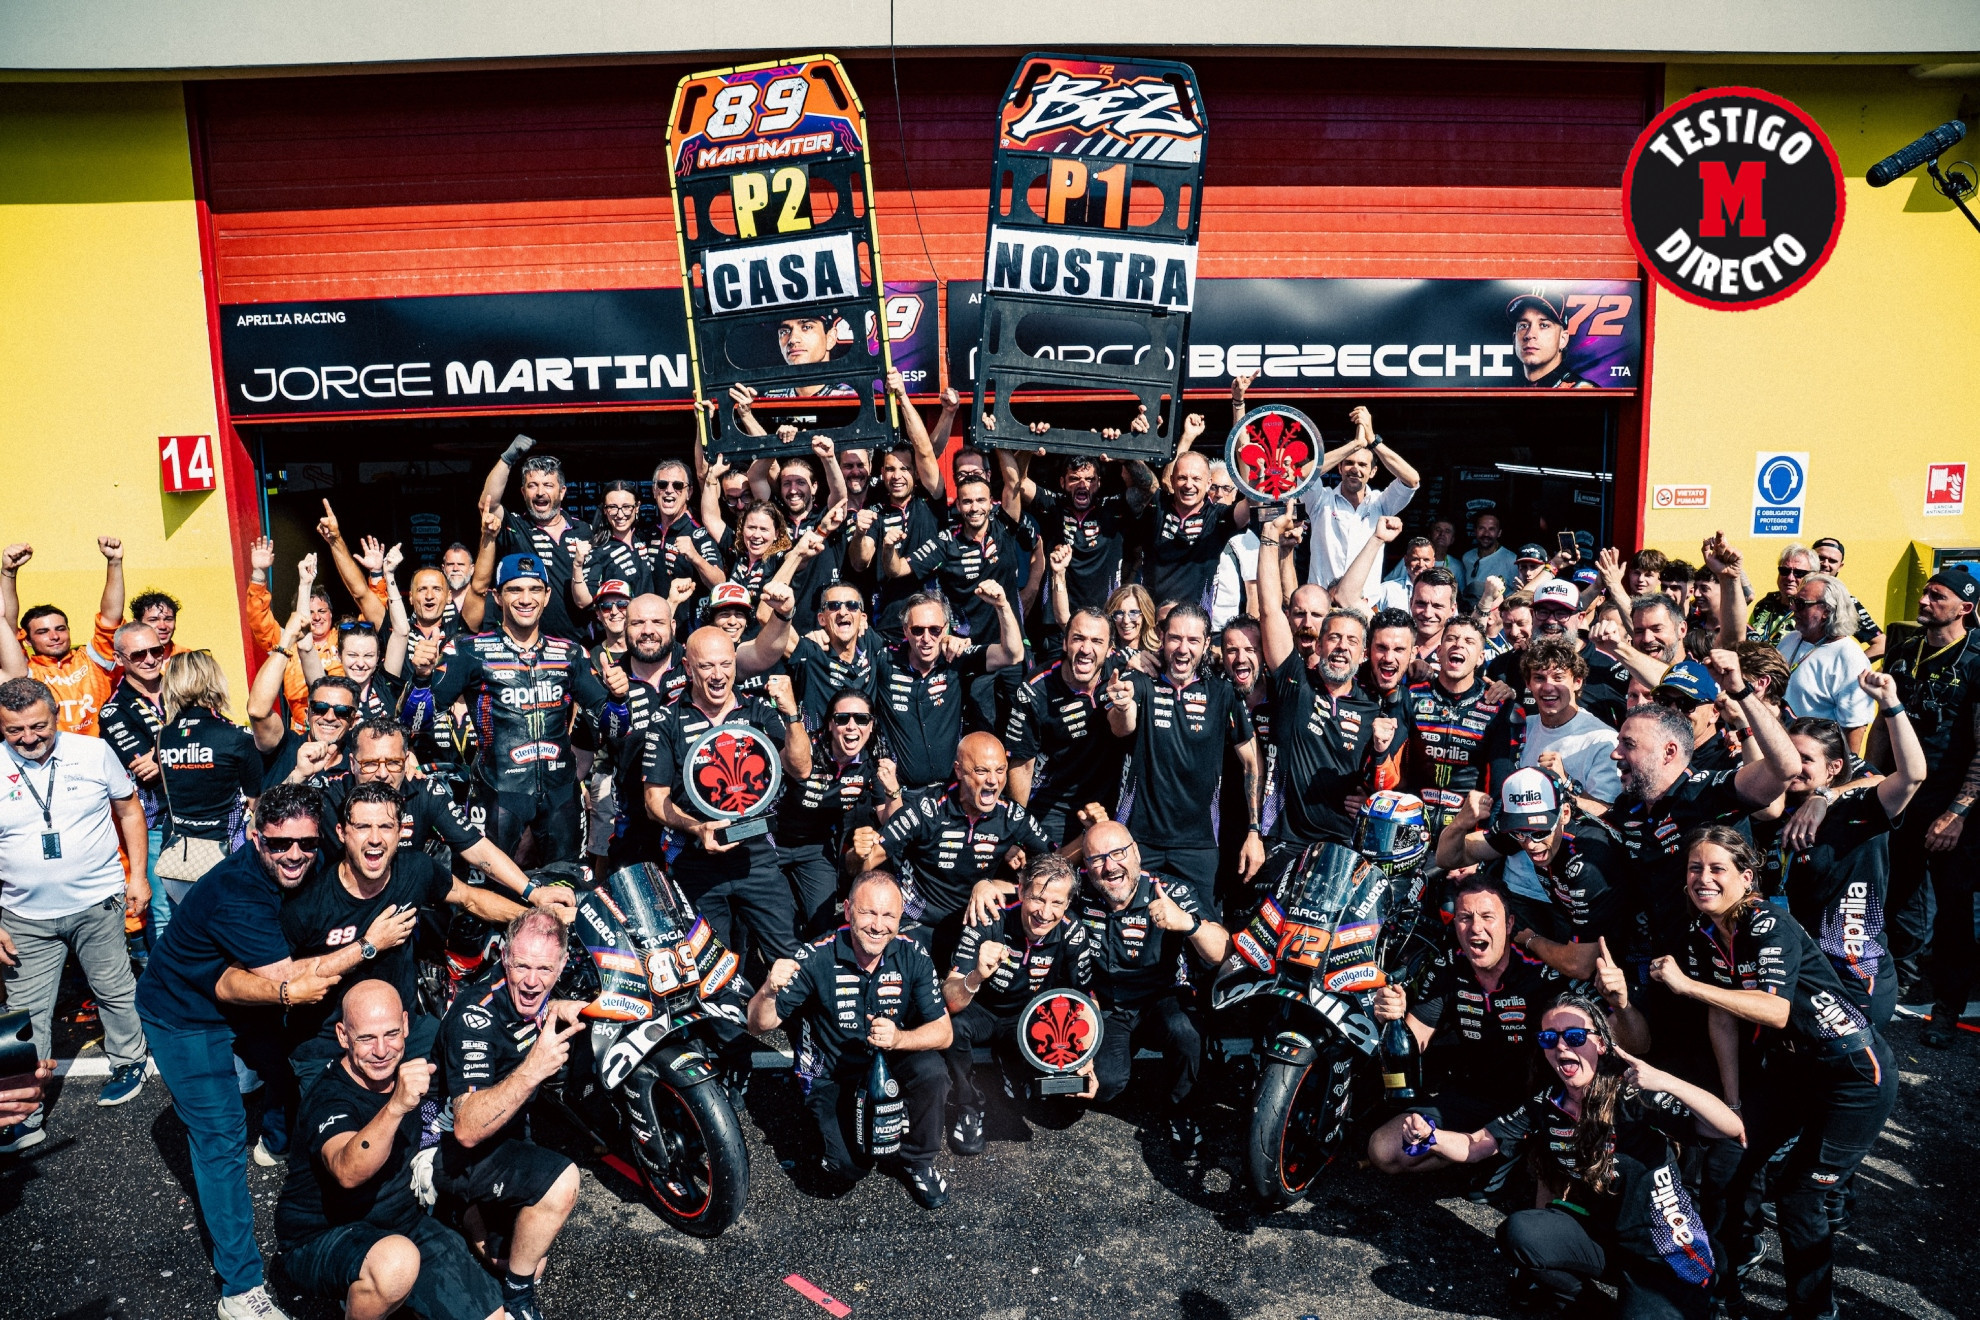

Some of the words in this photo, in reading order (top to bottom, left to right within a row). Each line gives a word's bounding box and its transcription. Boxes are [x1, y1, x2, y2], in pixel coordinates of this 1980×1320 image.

[1099, 64, 1115, 75] 72
[705, 76, 810, 139] 89
[1010, 75, 1199, 138] BEZ
[699, 133, 833, 167] MARTINATOR
[731, 167, 811, 239] P2
[1046, 158, 1128, 230] P1
[712, 250, 845, 312] CASA
[992, 242, 1188, 307] NOSTRA
[237, 313, 292, 327] APRILIA
[294, 311, 346, 325] RACING
[1566, 294, 1633, 336] 72
[1188, 344, 1514, 378] BEZZECCHI
[240, 363, 434, 403] JORGE
[446, 353, 689, 395] MARTIN
[902, 370, 927, 382] ESP
[1610, 366, 1632, 377] ITA
[161, 437, 214, 489] 14
[1676, 497, 1705, 505] FUMARE
[1762, 509, 1800, 517] OBBLIGATORIO
[717, 584, 747, 600] 72
[1541, 584, 1568, 595] aprilia
[500, 681, 563, 709] aprilia
[1183, 691, 1207, 703] aprilia
[1338, 708, 1362, 723] aprilia
[68, 718, 93, 732] TRACK
[1452, 736, 1477, 747] TARGA
[160, 742, 214, 768] aprilia
[1425, 744, 1469, 761] aprilia
[172, 762, 215, 770] RACING
[840, 774, 864, 786] aprilia
[1508, 789, 1542, 804] aprilia
[973, 832, 1000, 844] aprilia
[1121, 916, 1147, 928] aprilia
[1288, 906, 1328, 924] TARGA
[1844, 881, 1869, 958] aprilia
[326, 926, 358, 946] 89
[641, 929, 685, 949] TARGA
[1338, 927, 1373, 942] BS
[1238, 934, 1269, 970] sterilgarda
[1276, 921, 1332, 969] 72
[1229, 953, 1244, 971] sky
[1329, 948, 1365, 964] MONSTER
[646, 943, 701, 996] 89
[705, 955, 735, 993] sterilgarda
[1330, 967, 1375, 989] sterilgarda
[611, 976, 647, 991] MONSTER
[731, 973, 745, 993] sky
[602, 997, 647, 1017] sterilgarda
[1361, 989, 1376, 1007] sk
[1494, 995, 1526, 1009] aprilia
[593, 1023, 620, 1041] sky
[1651, 1164, 1696, 1248] aprilia
